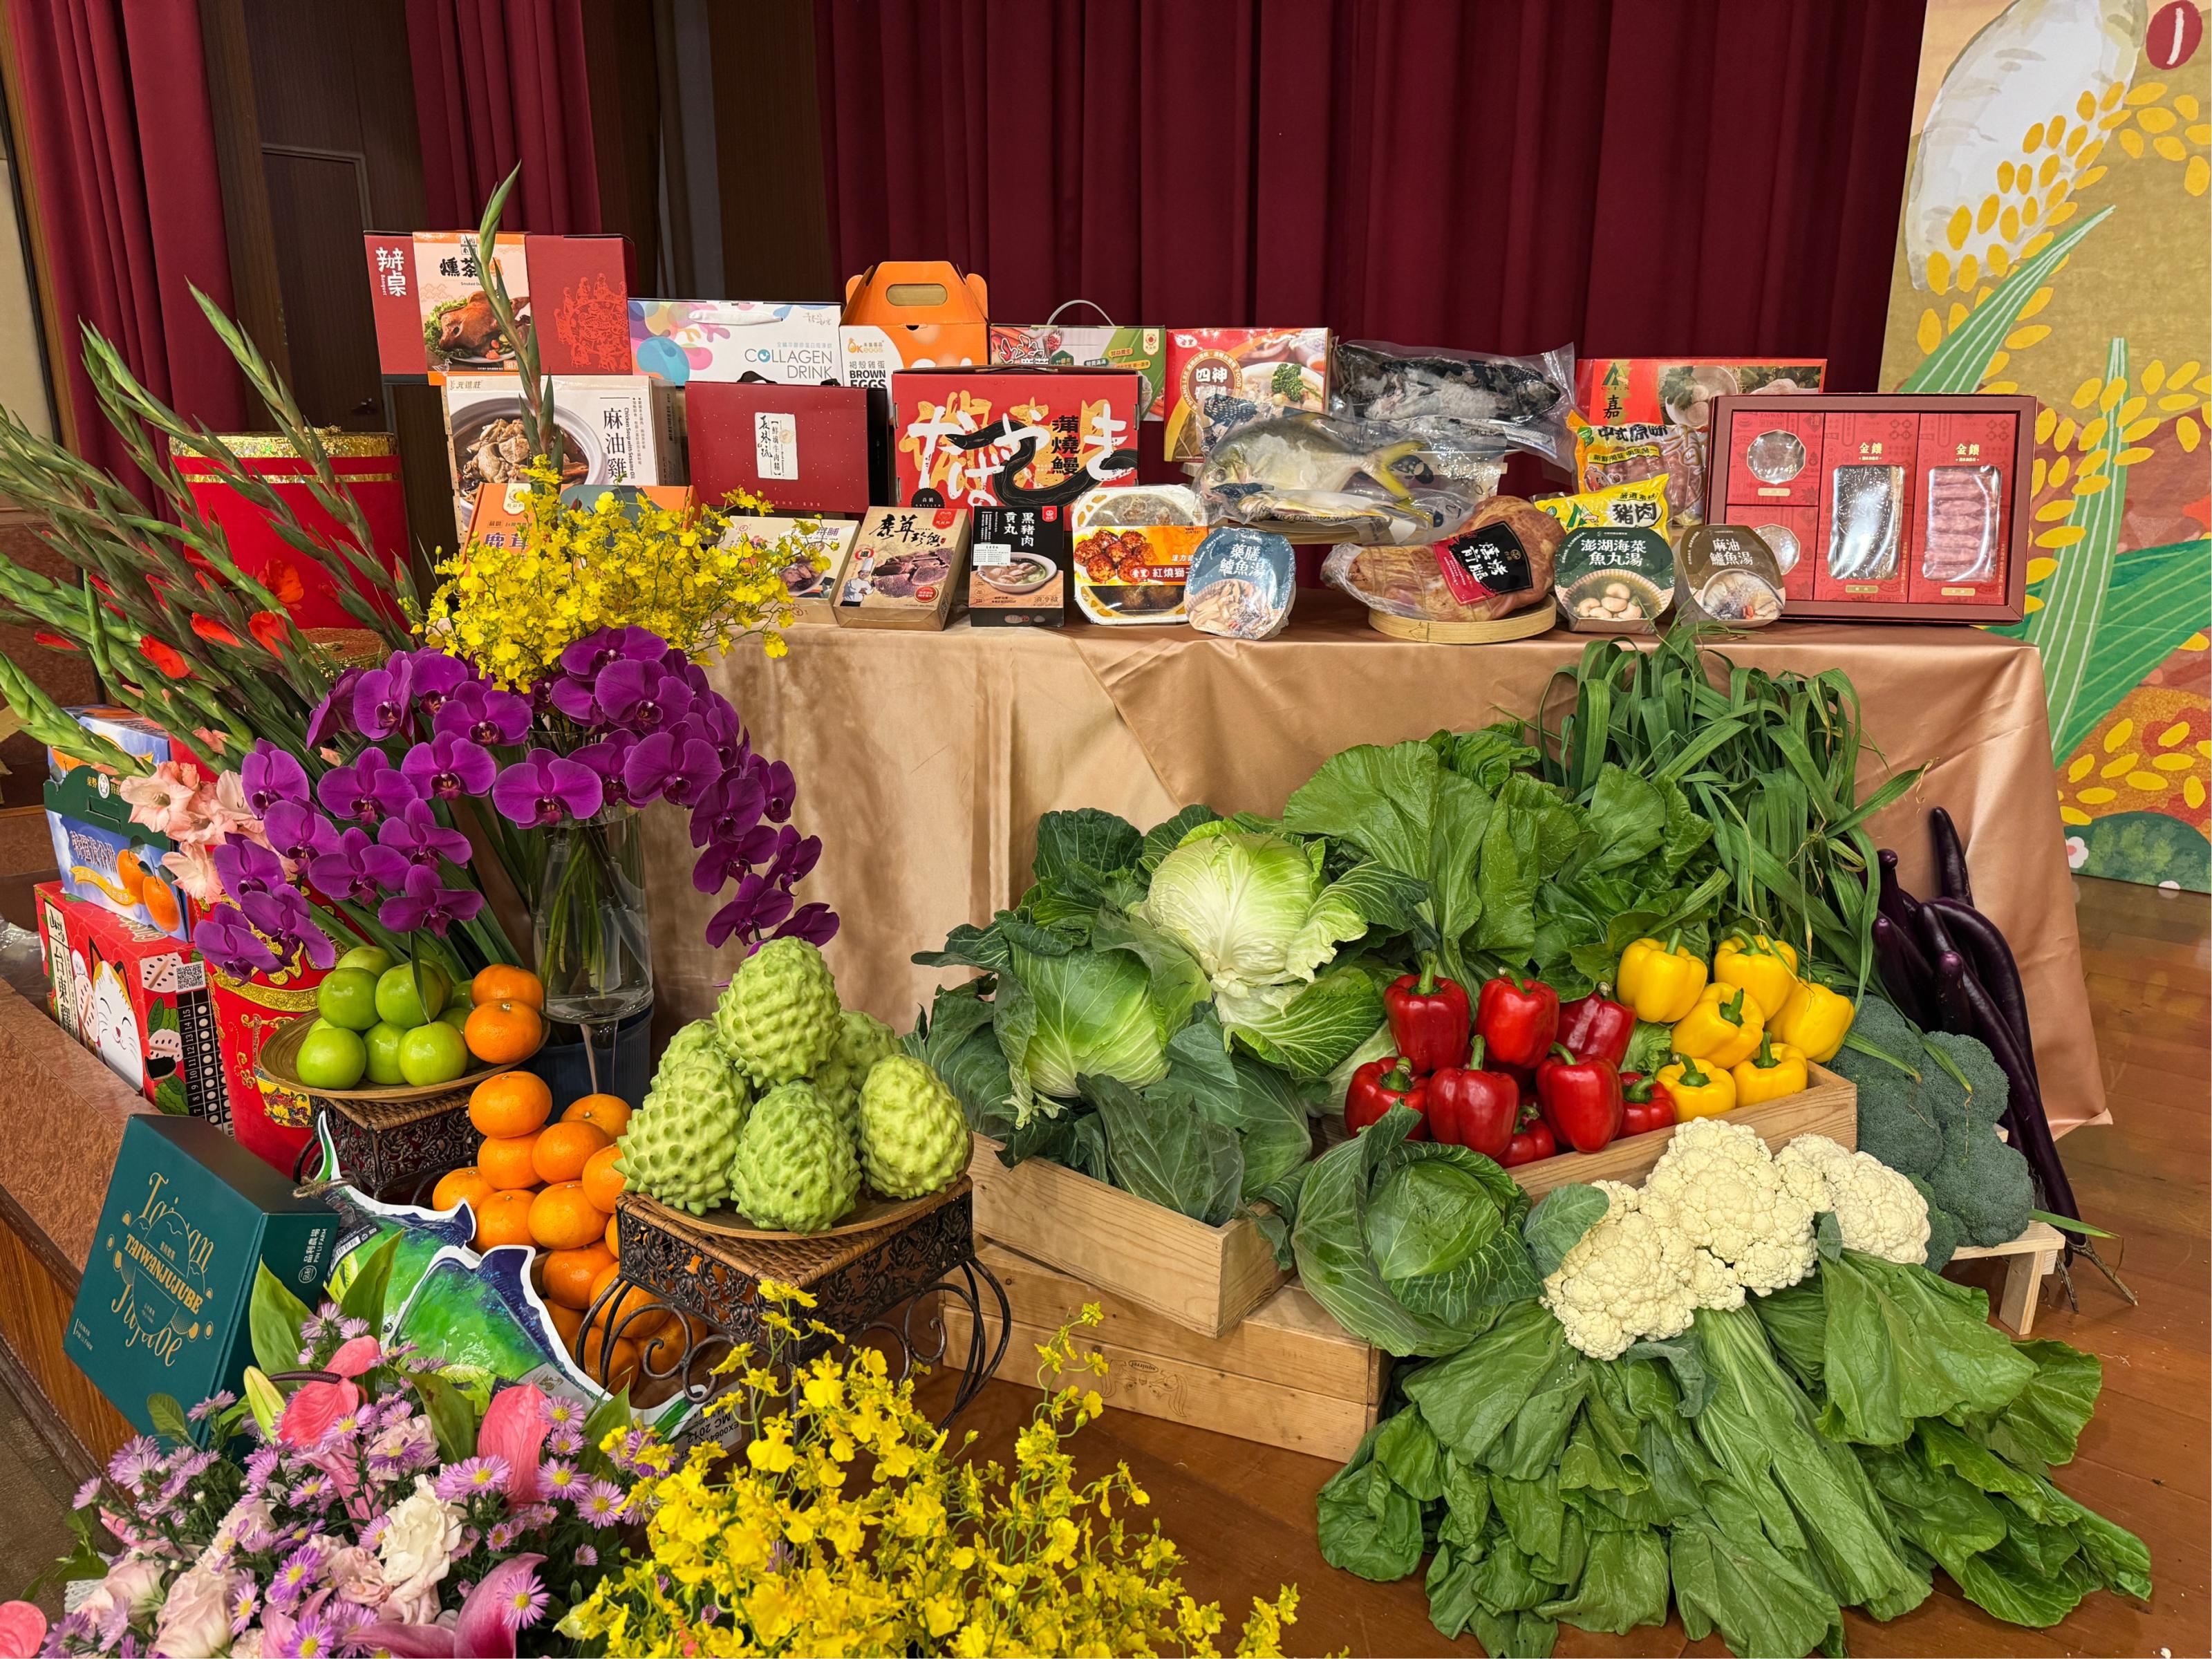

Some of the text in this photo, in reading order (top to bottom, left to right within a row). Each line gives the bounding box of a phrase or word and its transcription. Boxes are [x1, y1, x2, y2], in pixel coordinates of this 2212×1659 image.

[744, 348, 833, 364] COLLAGEN
[787, 365, 833, 379] DRINK
[849, 370, 886, 379] BROWN
[1195, 366, 1228, 384] 四神
[850, 379, 887, 388] EGGS
[1603, 395, 1623, 420] 嘉
[603, 407, 628, 480] 麻油雞
[1051, 415, 1080, 475] 蒲燒鰻
[1613, 503, 1657, 525] 豬肉
[1003, 512, 1018, 535] 貢丸
[1020, 512, 1035, 547] 黑豬肉
[1229, 543, 1261, 562] 藥膳
[1580, 539, 1647, 554] 澎湖海菜
[1712, 538, 1741, 552] 麻油
[1588, 552, 1644, 568] 魚丸湯
[1709, 552, 1754, 566] 鱸魚湯
[1219, 559, 1267, 578] 鱸魚湯
[182, 1008, 191, 1020] 15
[184, 1021, 193, 1032] 14
[185, 1033, 194, 1044] 13
[187, 1045, 196, 1056] 12
[188, 1058, 196, 1068] 11
[189, 1070, 198, 1080] 10
[319, 1228, 328, 1245] FARM
[124, 1233, 204, 1315] TAIWANJUJUBE
[1130, 1361, 1156, 1371] squirrel
[714, 1412, 731, 1428] MC
[706, 1421, 740, 1443] EX0064
